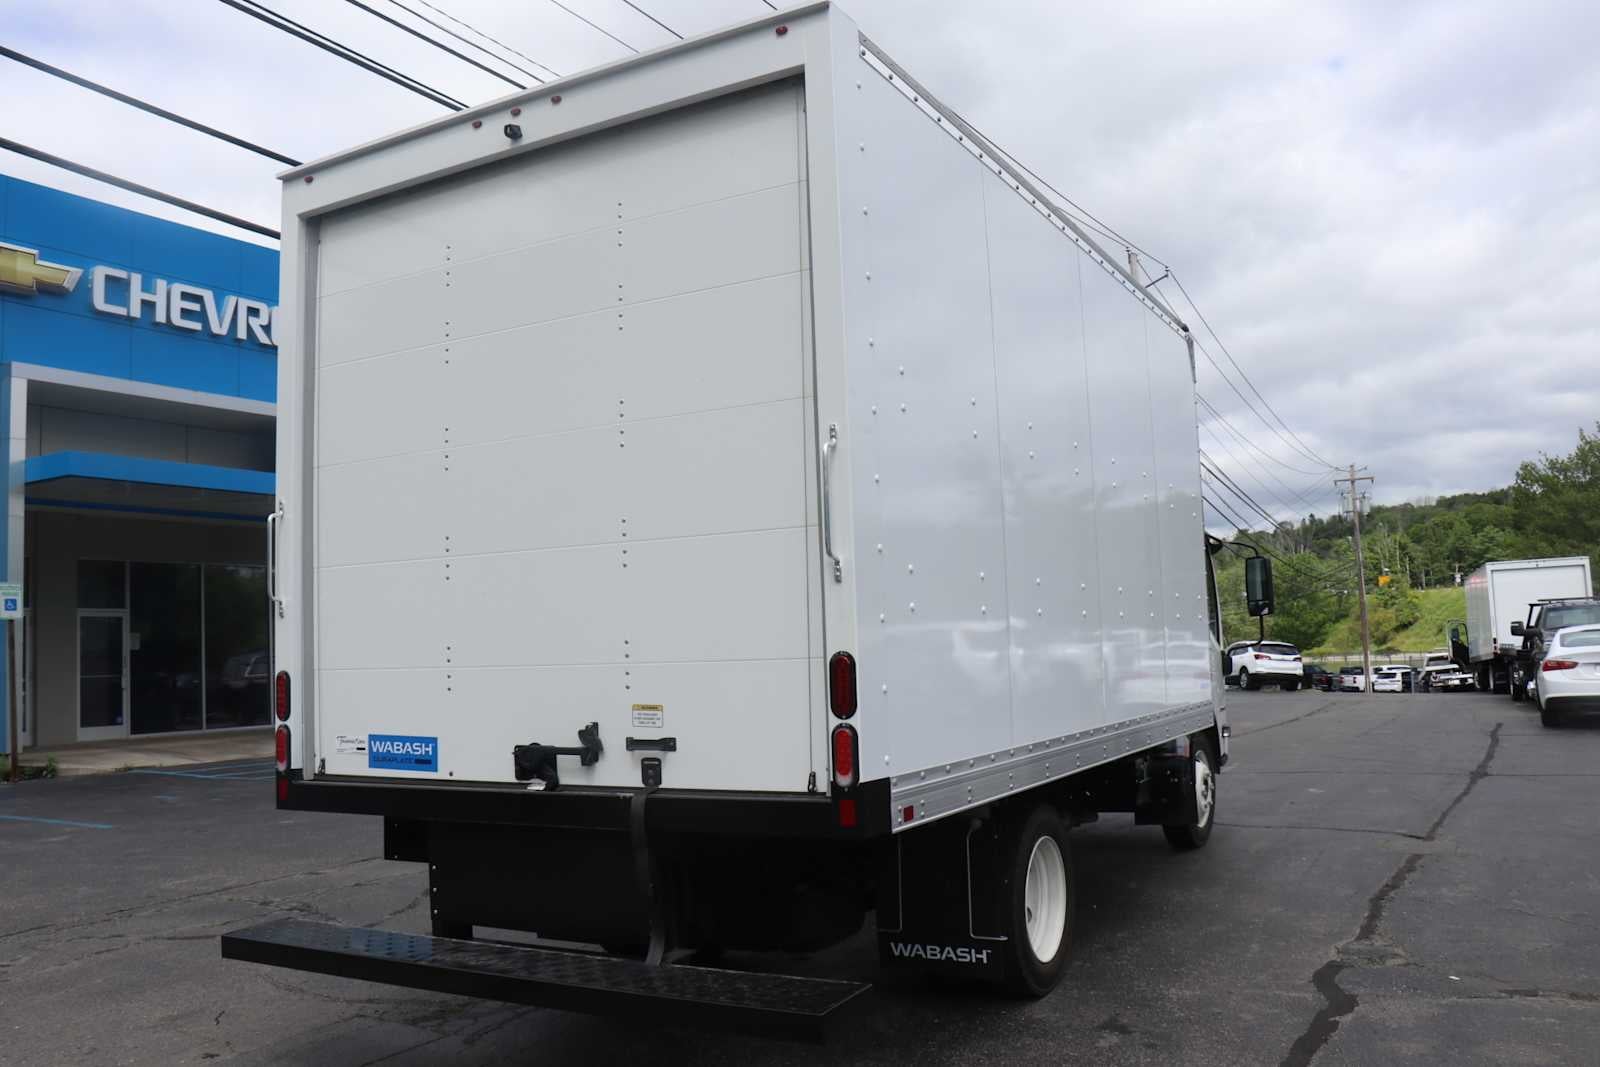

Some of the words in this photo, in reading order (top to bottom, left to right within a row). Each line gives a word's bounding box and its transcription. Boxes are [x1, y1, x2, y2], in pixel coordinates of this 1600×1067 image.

[92, 265, 279, 348] CHEVR
[371, 740, 432, 755] WABASH
[890, 942, 988, 964] WABASH
